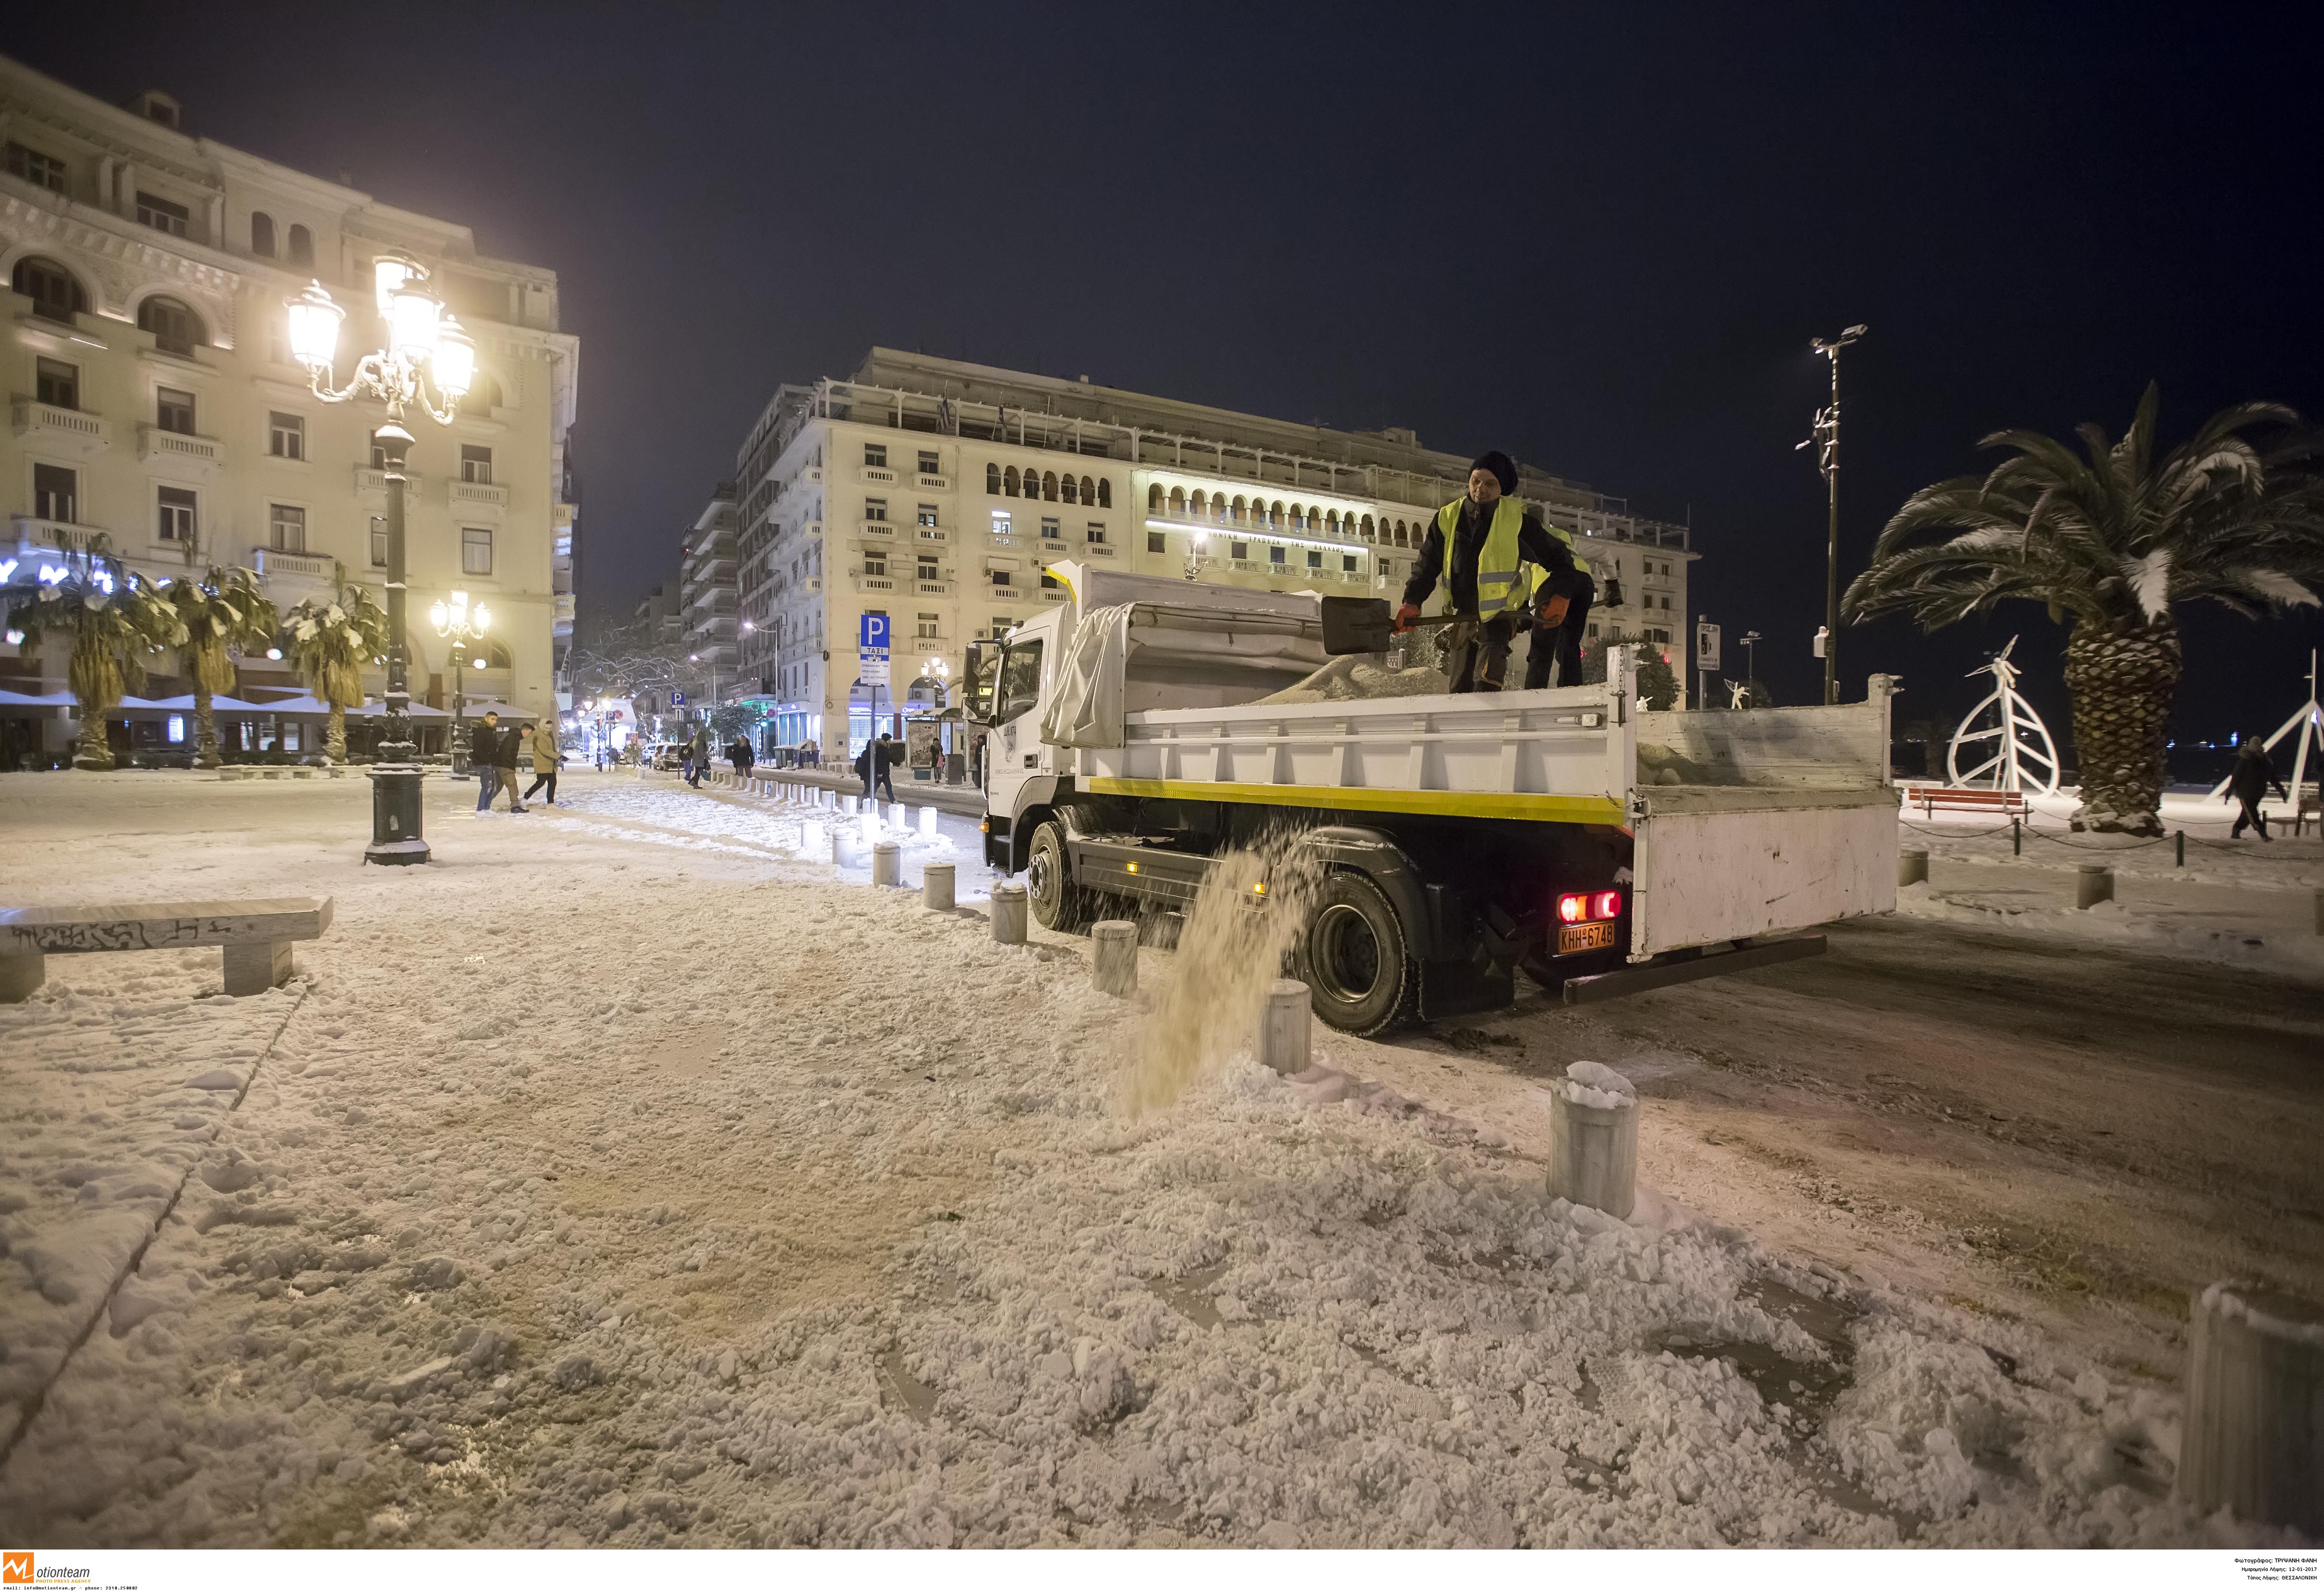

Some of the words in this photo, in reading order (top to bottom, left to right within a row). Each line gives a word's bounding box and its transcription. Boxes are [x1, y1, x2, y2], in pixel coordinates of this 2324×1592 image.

[1208, 531, 1238, 539] ΕΘΝΙΚΗ
[1249, 536, 1280, 545] ΤΡΑΠΕΖΑ
[1314, 544, 1344, 553] ΕΛΛΑΔΟΣ
[868, 617, 883, 644] P
[674, 693, 682, 705] P
[1560, 924, 1613, 951] KHH-6748
